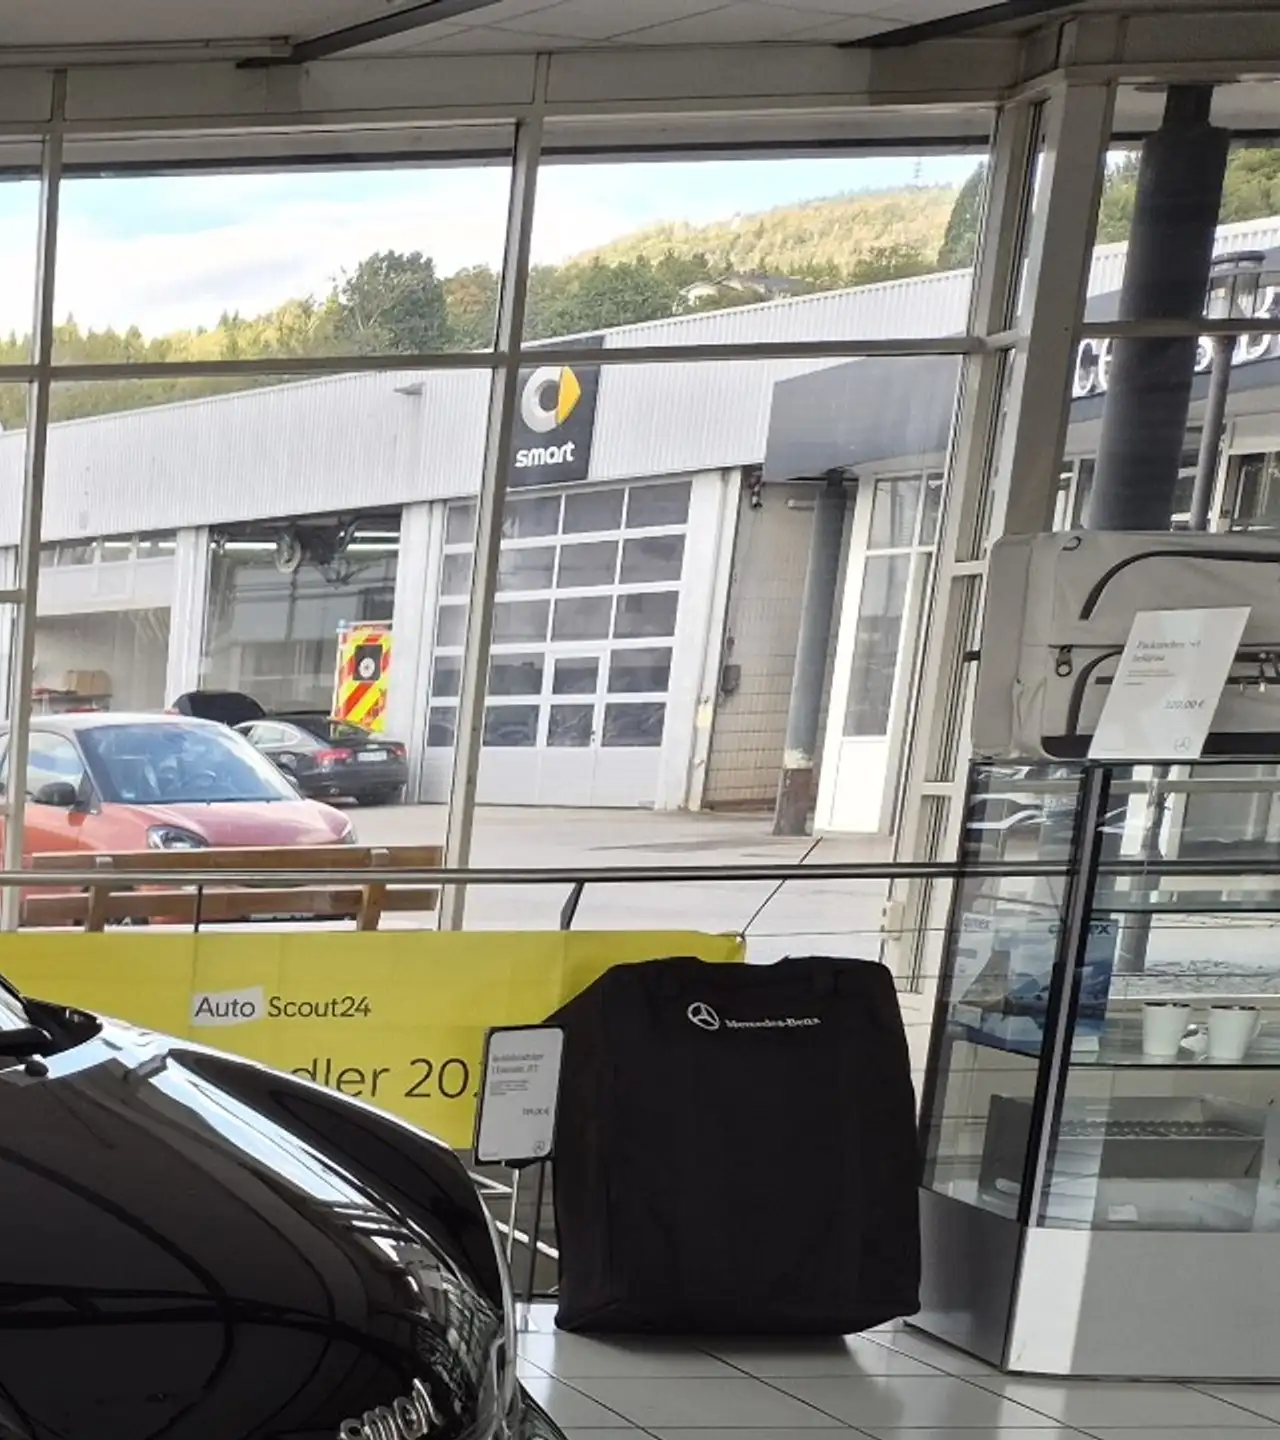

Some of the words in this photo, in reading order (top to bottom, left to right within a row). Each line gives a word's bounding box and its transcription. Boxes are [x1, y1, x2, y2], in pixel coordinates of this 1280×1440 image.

[514, 440, 575, 468] smart
[193, 996, 256, 1018] Auto
[267, 995, 372, 1018] Scout24
